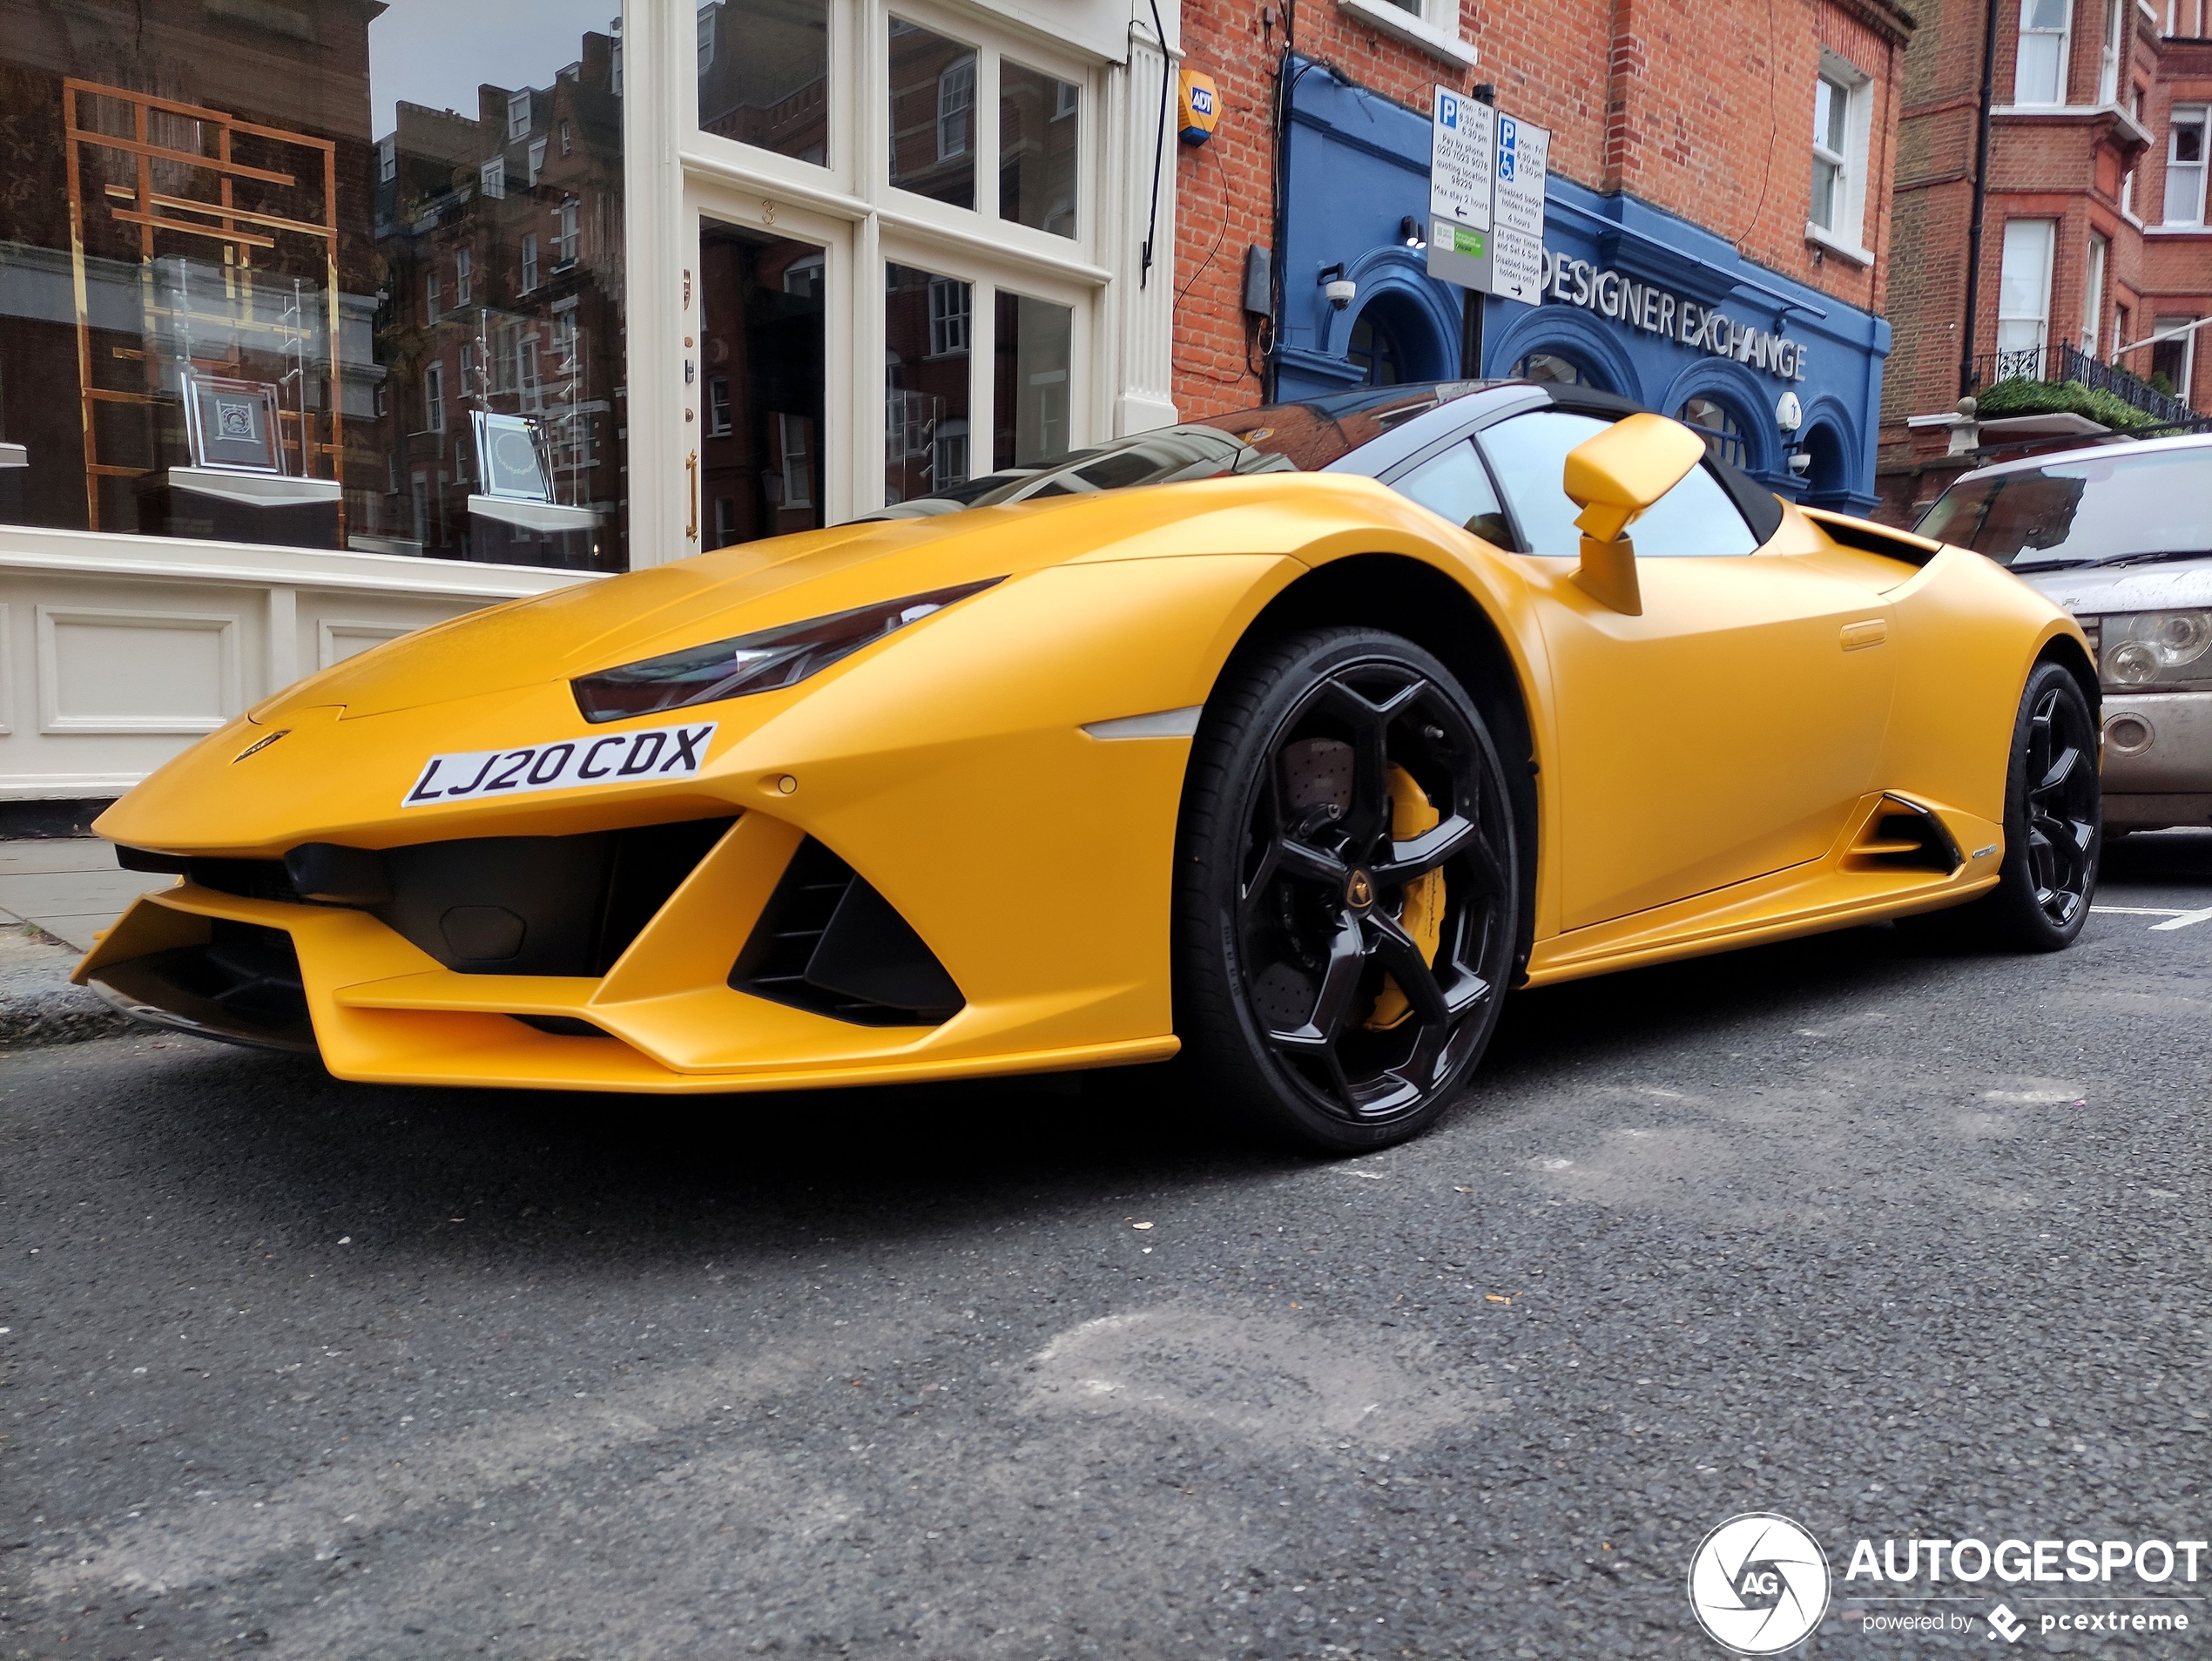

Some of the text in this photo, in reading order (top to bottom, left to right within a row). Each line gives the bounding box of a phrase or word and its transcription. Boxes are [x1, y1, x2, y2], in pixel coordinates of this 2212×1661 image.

[1193, 91, 1211, 112] ADT
[1443, 98, 1455, 124] P
[1460, 98, 1474, 112] Mon
[1478, 106, 1489, 119] Sat
[1475, 121, 1485, 131] am
[1502, 120, 1514, 145] P
[1442, 133, 1484, 159] Pay by phone
[1478, 134, 1488, 145] pm
[1518, 138, 1531, 152] Mon
[1535, 145, 1544, 157] Fri
[1437, 144, 1451, 158] 020
[1436, 159, 1487, 185] quoting location
[1532, 158, 1541, 167] am
[1534, 170, 1543, 179] pm
[1433, 183, 1488, 212] Max stay 2 hours
[1498, 184, 1541, 208] Disabled badge
[762, 199, 775, 225] 3
[1501, 196, 1537, 219] holders only
[1514, 215, 1530, 229] hours
[1497, 228, 1539, 251] At other times
[1497, 241, 1508, 252] and
[1510, 243, 1520, 255] Sat
[1527, 249, 1539, 261] Sun
[1495, 253, 1540, 275] Disabled badge
[1499, 266, 1535, 287] holders only
[1677, 300, 1807, 381] EXCHANGE
[408, 726, 713, 802] LJ20 CDX
